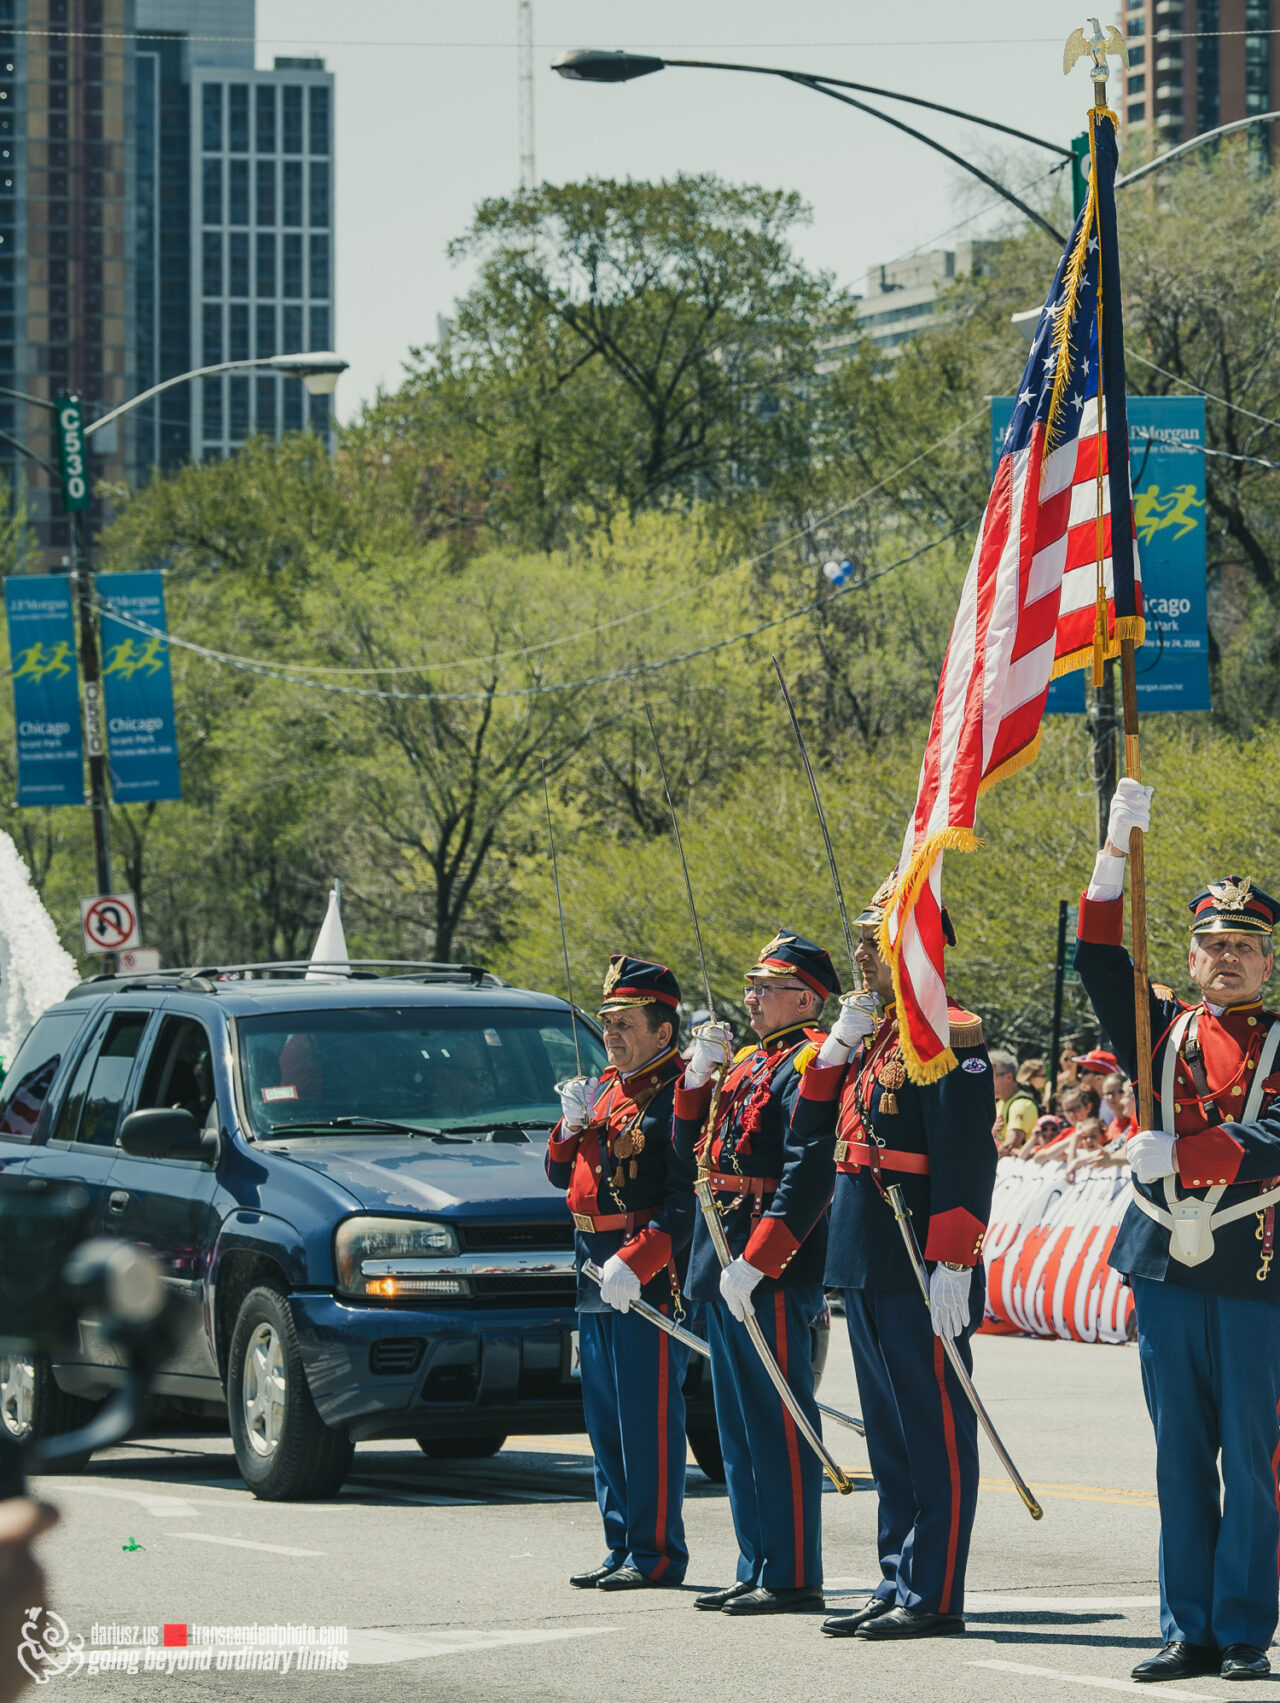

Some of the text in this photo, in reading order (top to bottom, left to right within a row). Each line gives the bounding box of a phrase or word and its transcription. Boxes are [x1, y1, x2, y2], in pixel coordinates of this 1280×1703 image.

[60, 408, 85, 499] C530
[1144, 595, 1190, 617] icago
[19, 721, 70, 737] Chicago
[109, 717, 163, 733] Chicago
